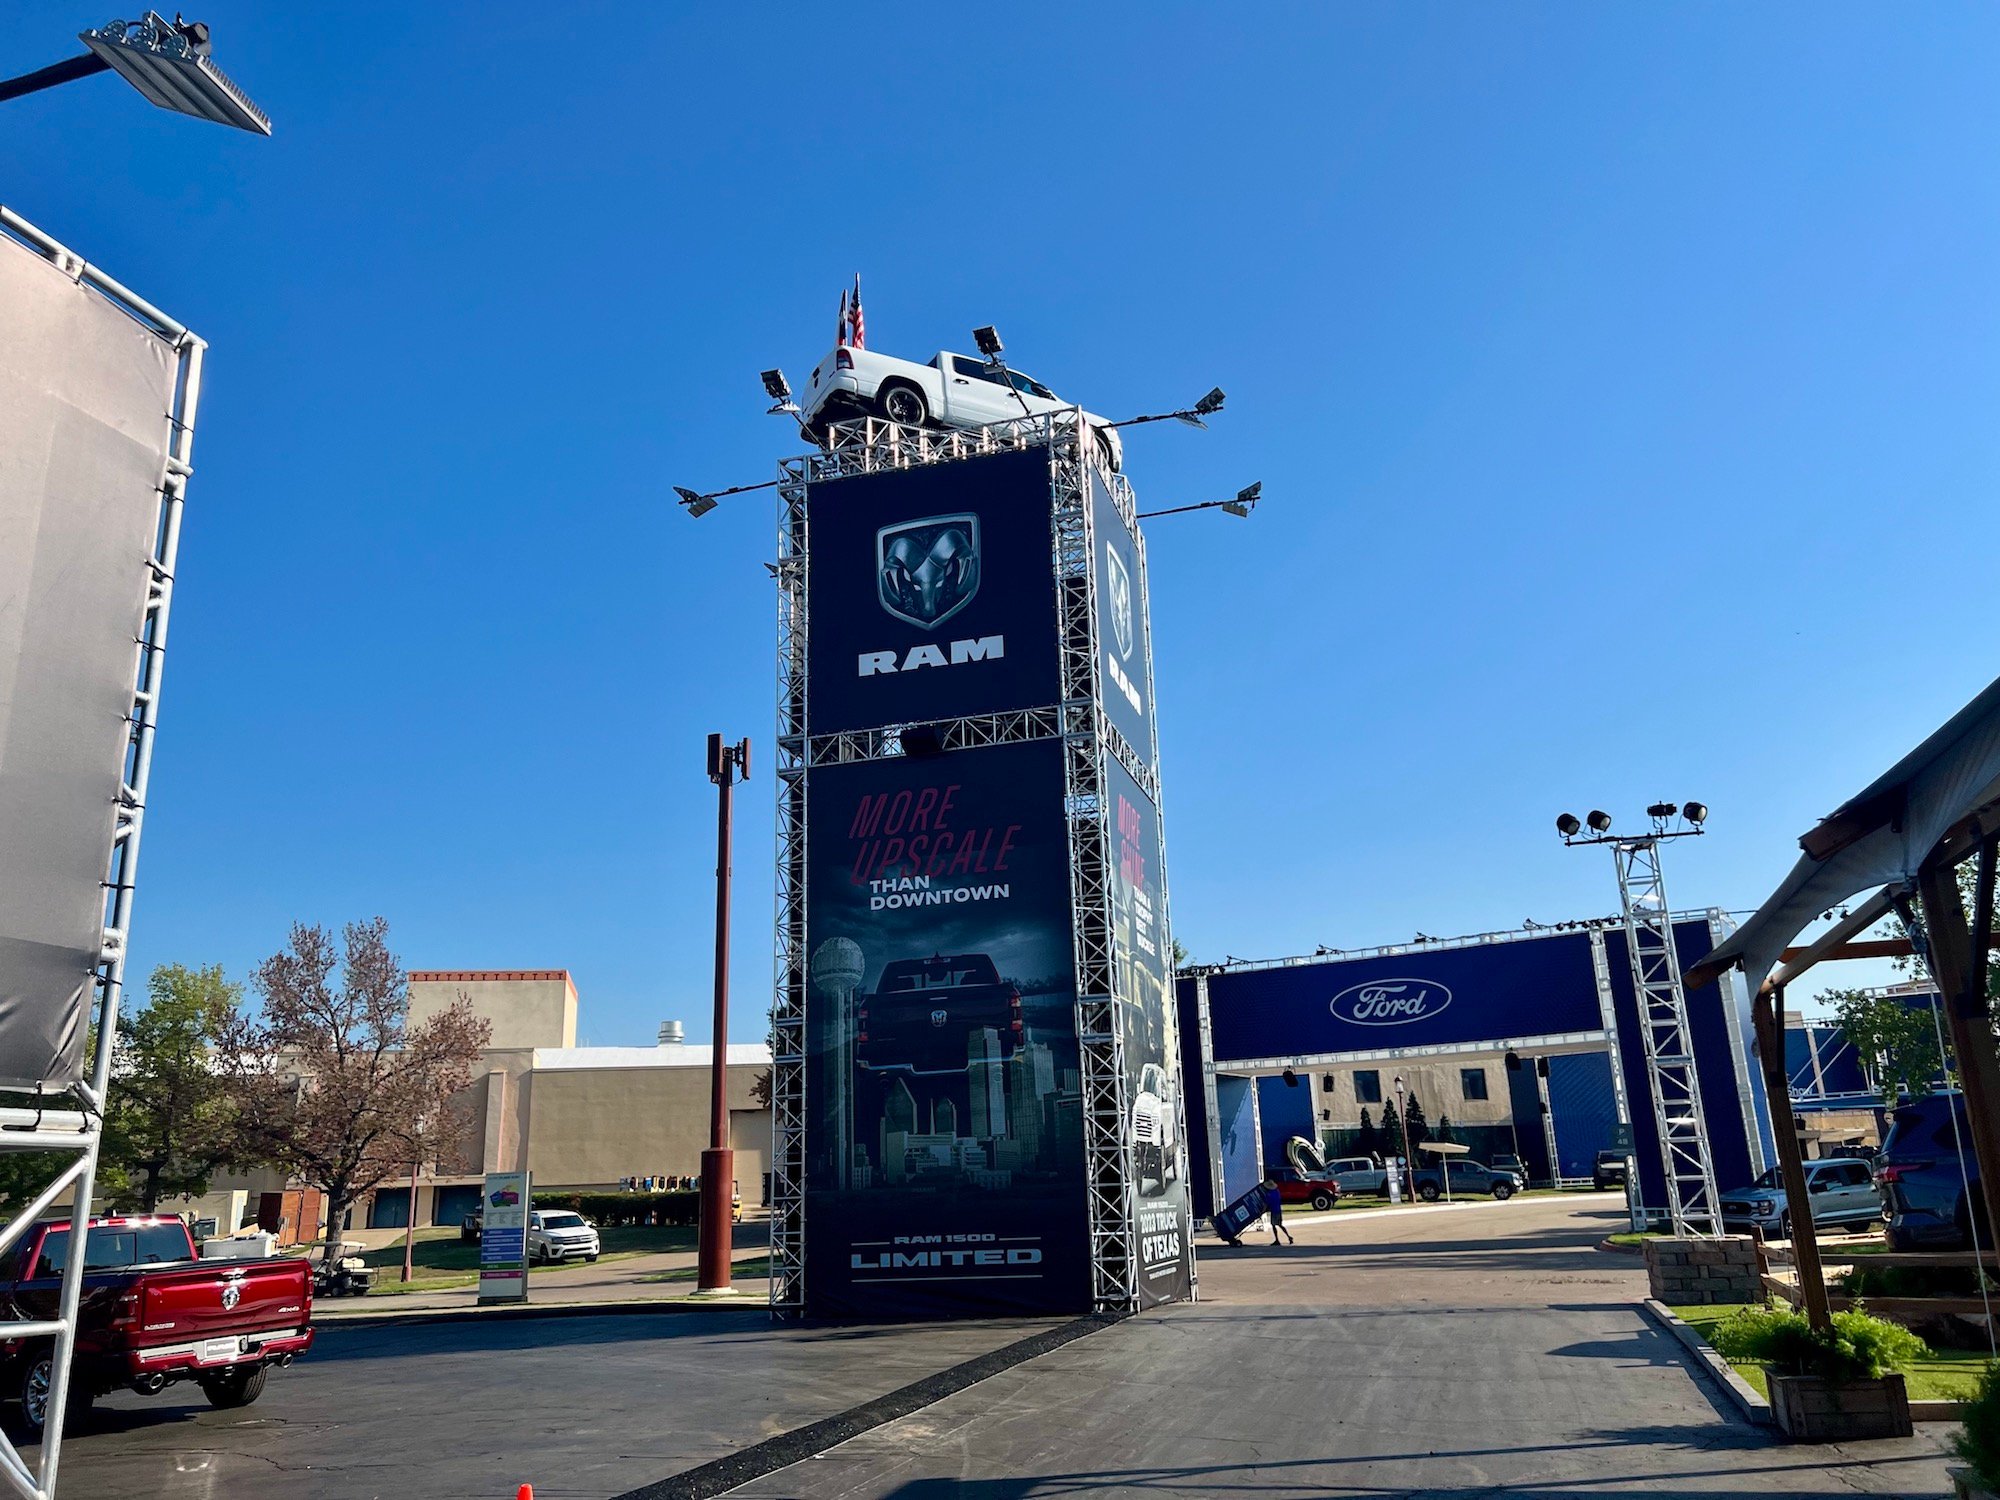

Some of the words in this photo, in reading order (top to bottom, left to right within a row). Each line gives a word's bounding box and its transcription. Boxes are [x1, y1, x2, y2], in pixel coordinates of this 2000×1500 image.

[858, 635, 1004, 677] RAM
[1108, 652, 1141, 716] RAM
[849, 785, 961, 838] MORE
[1118, 794, 1141, 851] MORE
[851, 825, 1022, 885] UPSCALE
[870, 875, 930, 894] THAN
[870, 884, 1010, 911] DOWNTOWN
[1353, 985, 1427, 1019] Ford
[894, 1235, 941, 1244] RAM
[945, 1233, 995, 1242] 1500
[1140, 1212, 1156, 1234] 2023
[1156, 1211, 1178, 1231] TRUCK
[851, 1249, 1042, 1269] LIMITED
[1142, 1236, 1153, 1263] OF
[1153, 1232, 1180, 1260] TEXAS
